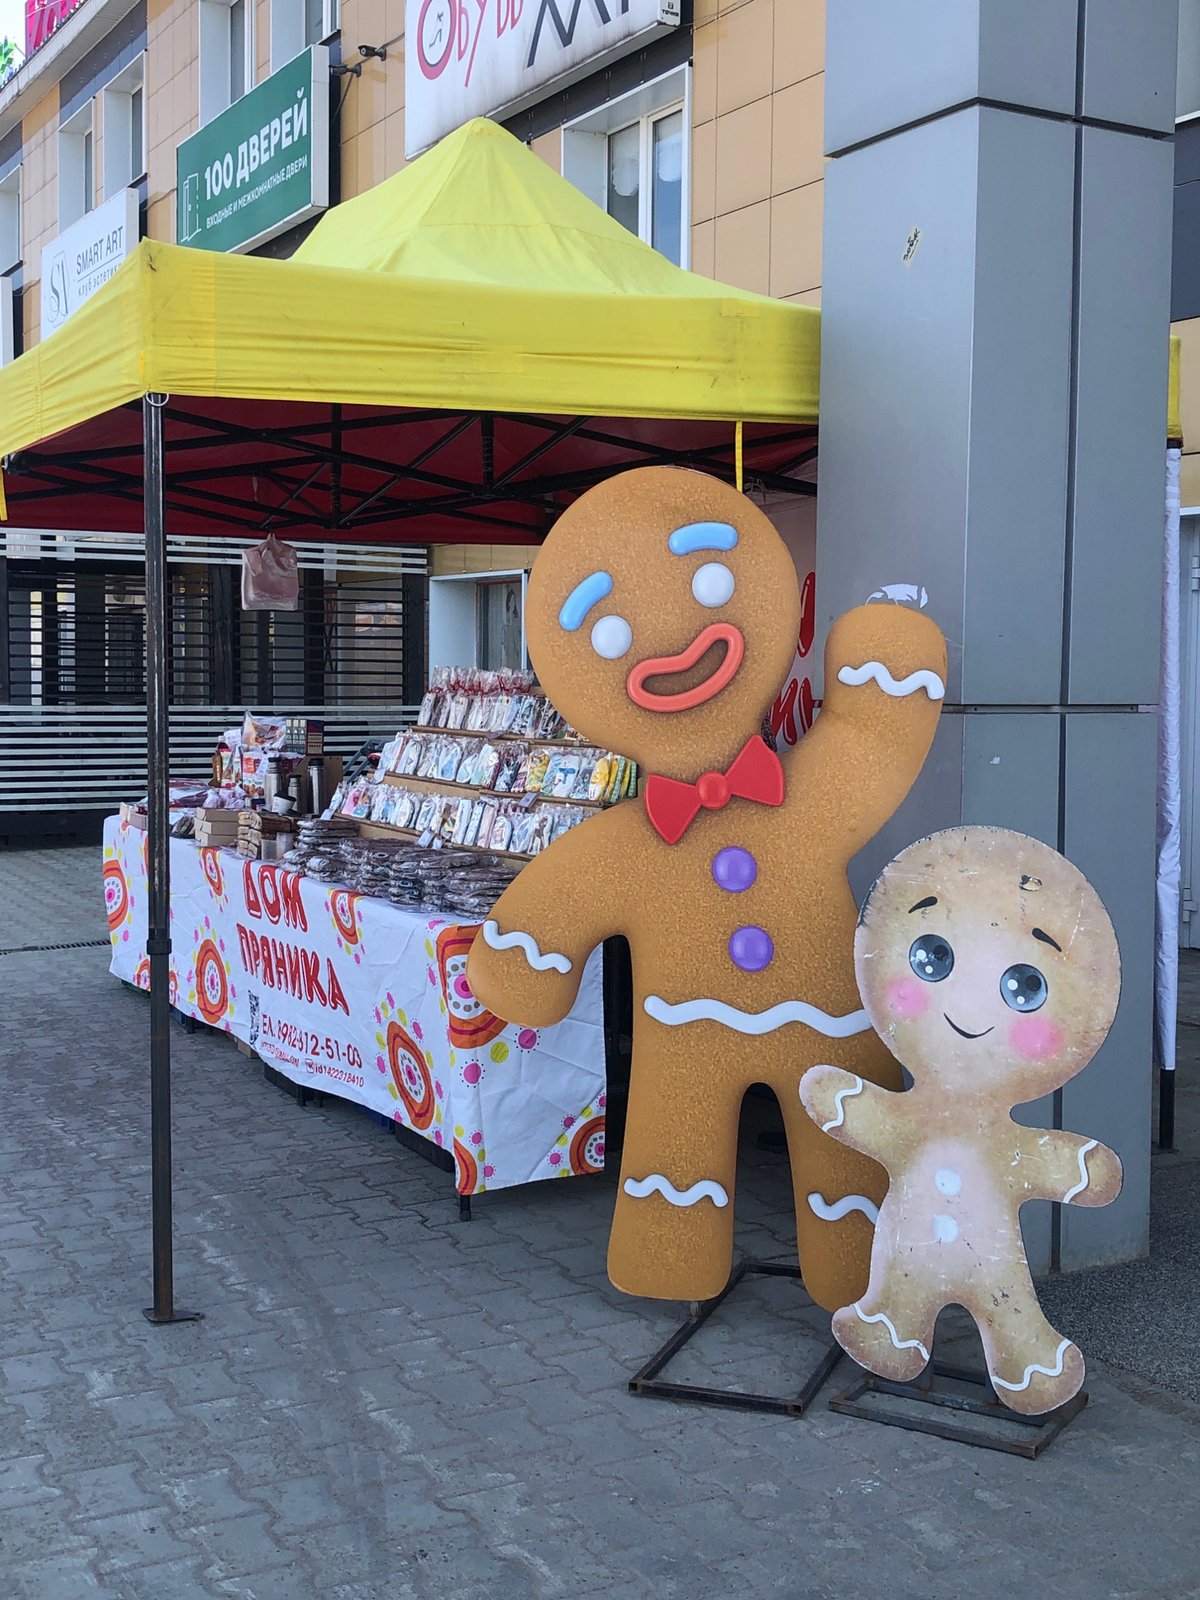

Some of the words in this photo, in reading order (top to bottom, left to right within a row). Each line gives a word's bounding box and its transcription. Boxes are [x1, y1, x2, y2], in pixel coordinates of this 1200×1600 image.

[204, 152, 234, 200] 100
[236, 86, 307, 188] ДВЕРЕЙ
[206, 203, 233, 229] ВХОДНЫЕ
[238, 167, 285, 210] МЕЖКОМНАТНЫЕ
[285, 154, 307, 181] ДВЕРИ
[76, 238, 104, 275] SMART
[105, 225, 123, 257] ART
[242, 859, 308, 933] ДОМ
[236, 923, 350, 1017] ПРЯНИКА
